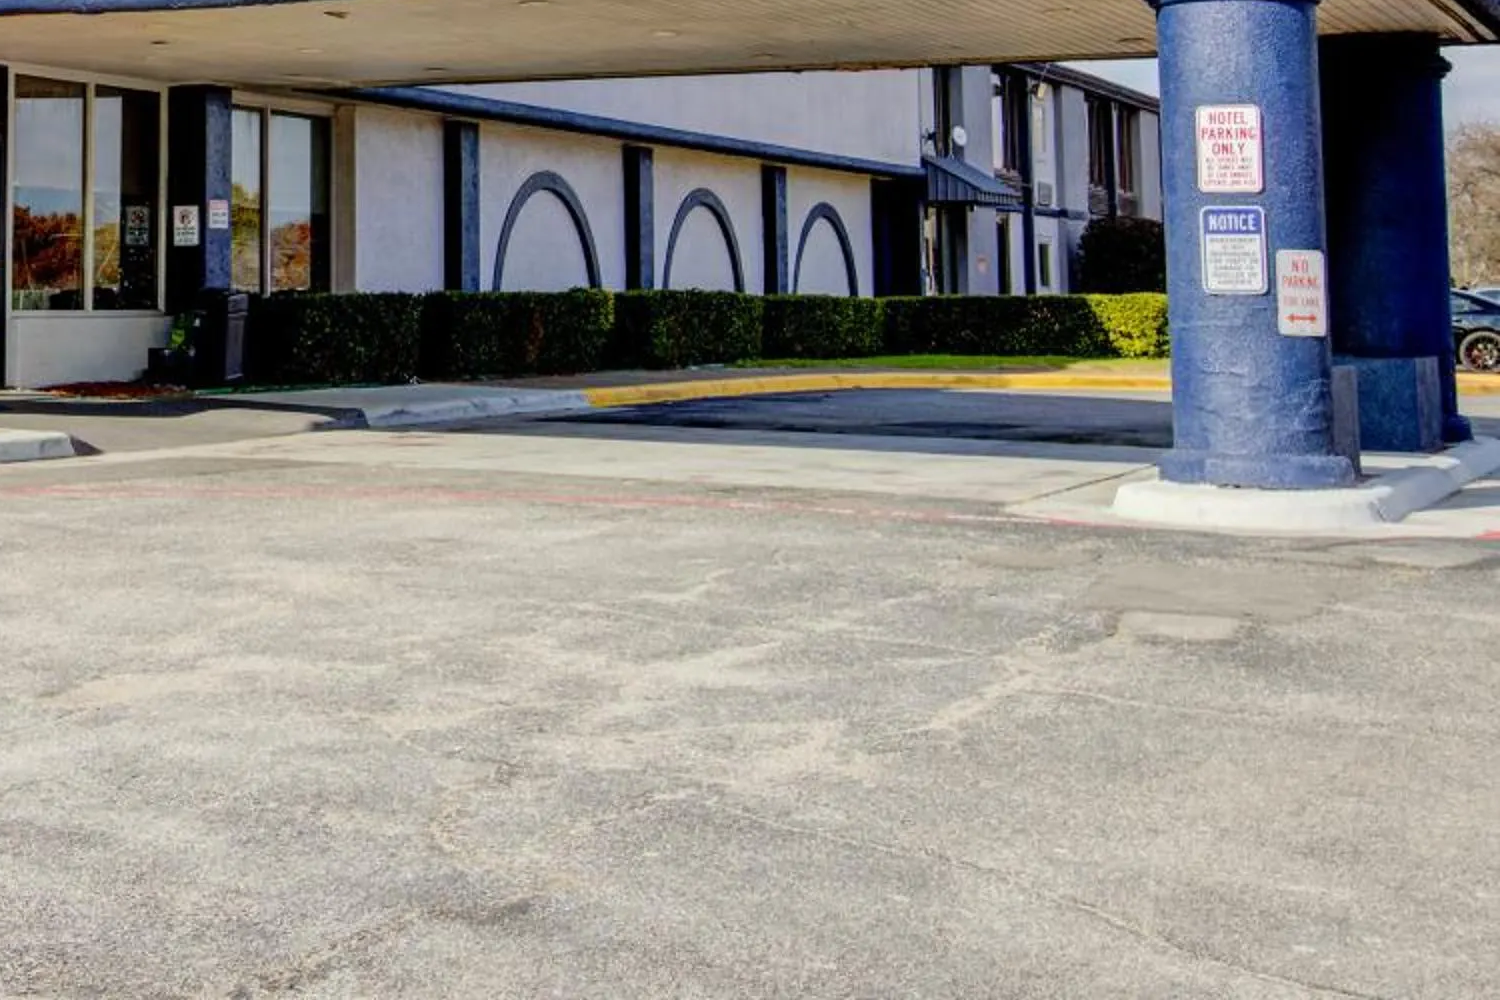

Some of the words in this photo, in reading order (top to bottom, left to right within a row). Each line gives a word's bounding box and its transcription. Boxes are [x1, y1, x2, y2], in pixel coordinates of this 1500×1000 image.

[1208, 111, 1248, 125] HOTEL
[1201, 127, 1257, 140] PARKING
[1211, 143, 1246, 156] ONLY
[1208, 212, 1257, 232] NOTICE
[1291, 257, 1309, 273] NO
